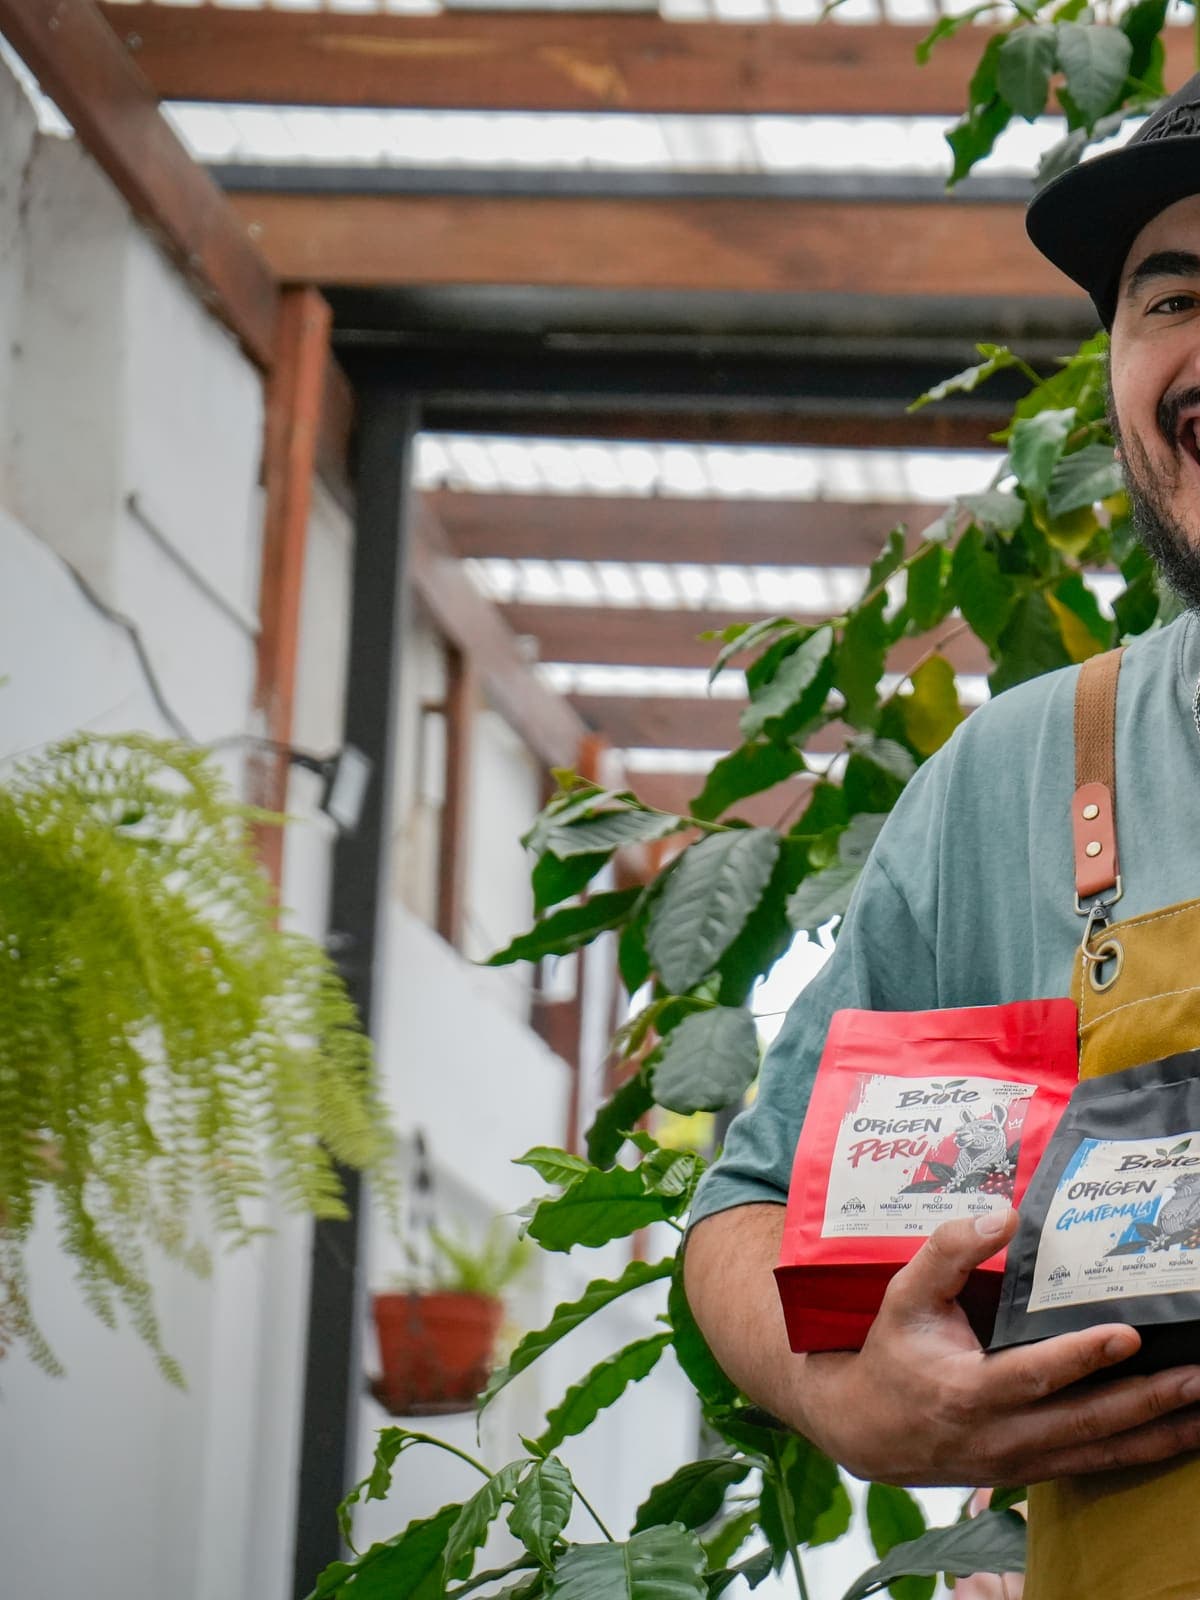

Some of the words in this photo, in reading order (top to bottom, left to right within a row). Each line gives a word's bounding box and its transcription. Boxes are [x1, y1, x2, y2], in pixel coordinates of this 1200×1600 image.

[896, 1089, 981, 1109] Brote
[847, 1134, 929, 1169] PERÚ
[1114, 1154, 1200, 1172] Brote
[1055, 1200, 1153, 1231] GUATEMALA
[904, 1223, 920, 1231] 250
